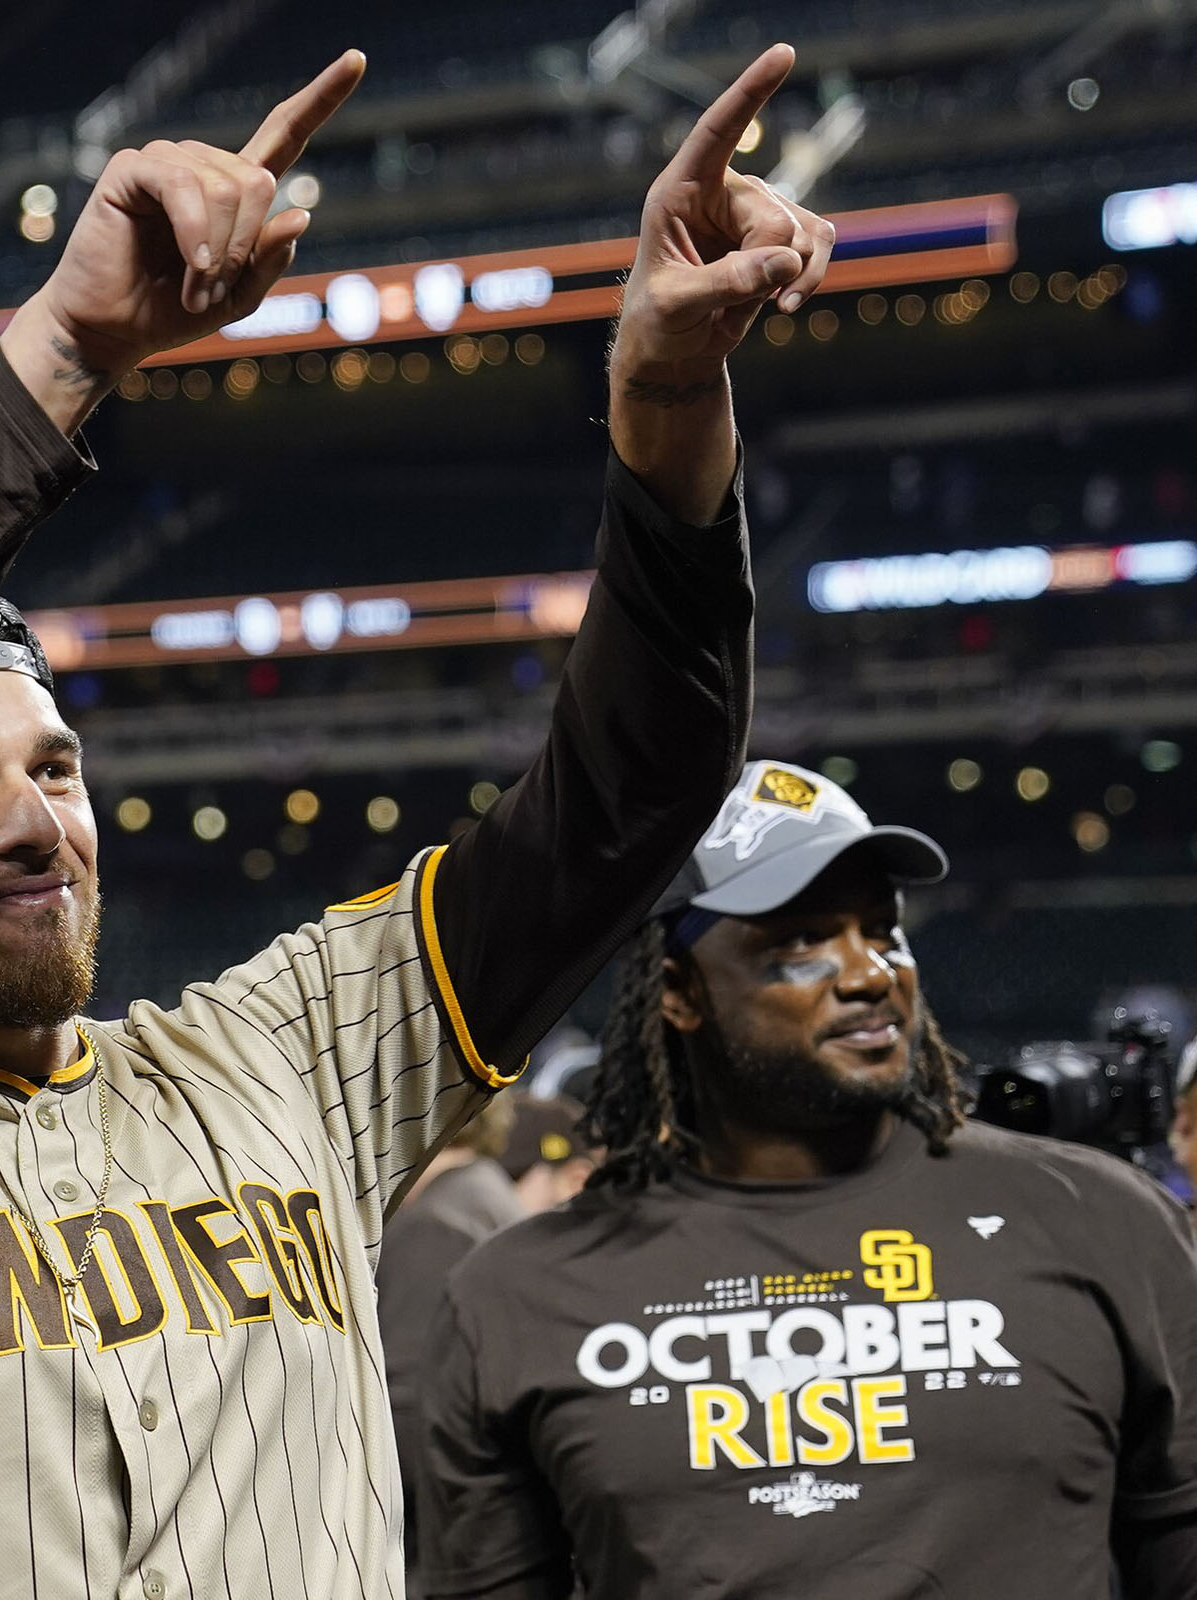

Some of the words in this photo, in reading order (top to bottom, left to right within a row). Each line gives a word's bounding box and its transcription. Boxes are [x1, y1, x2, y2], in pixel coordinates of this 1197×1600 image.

[46, 1180, 347, 1354] DIEGO
[859, 1229, 934, 1302] SD
[576, 1299, 1021, 1388] OCTOBER
[685, 1374, 916, 1470] RISE
